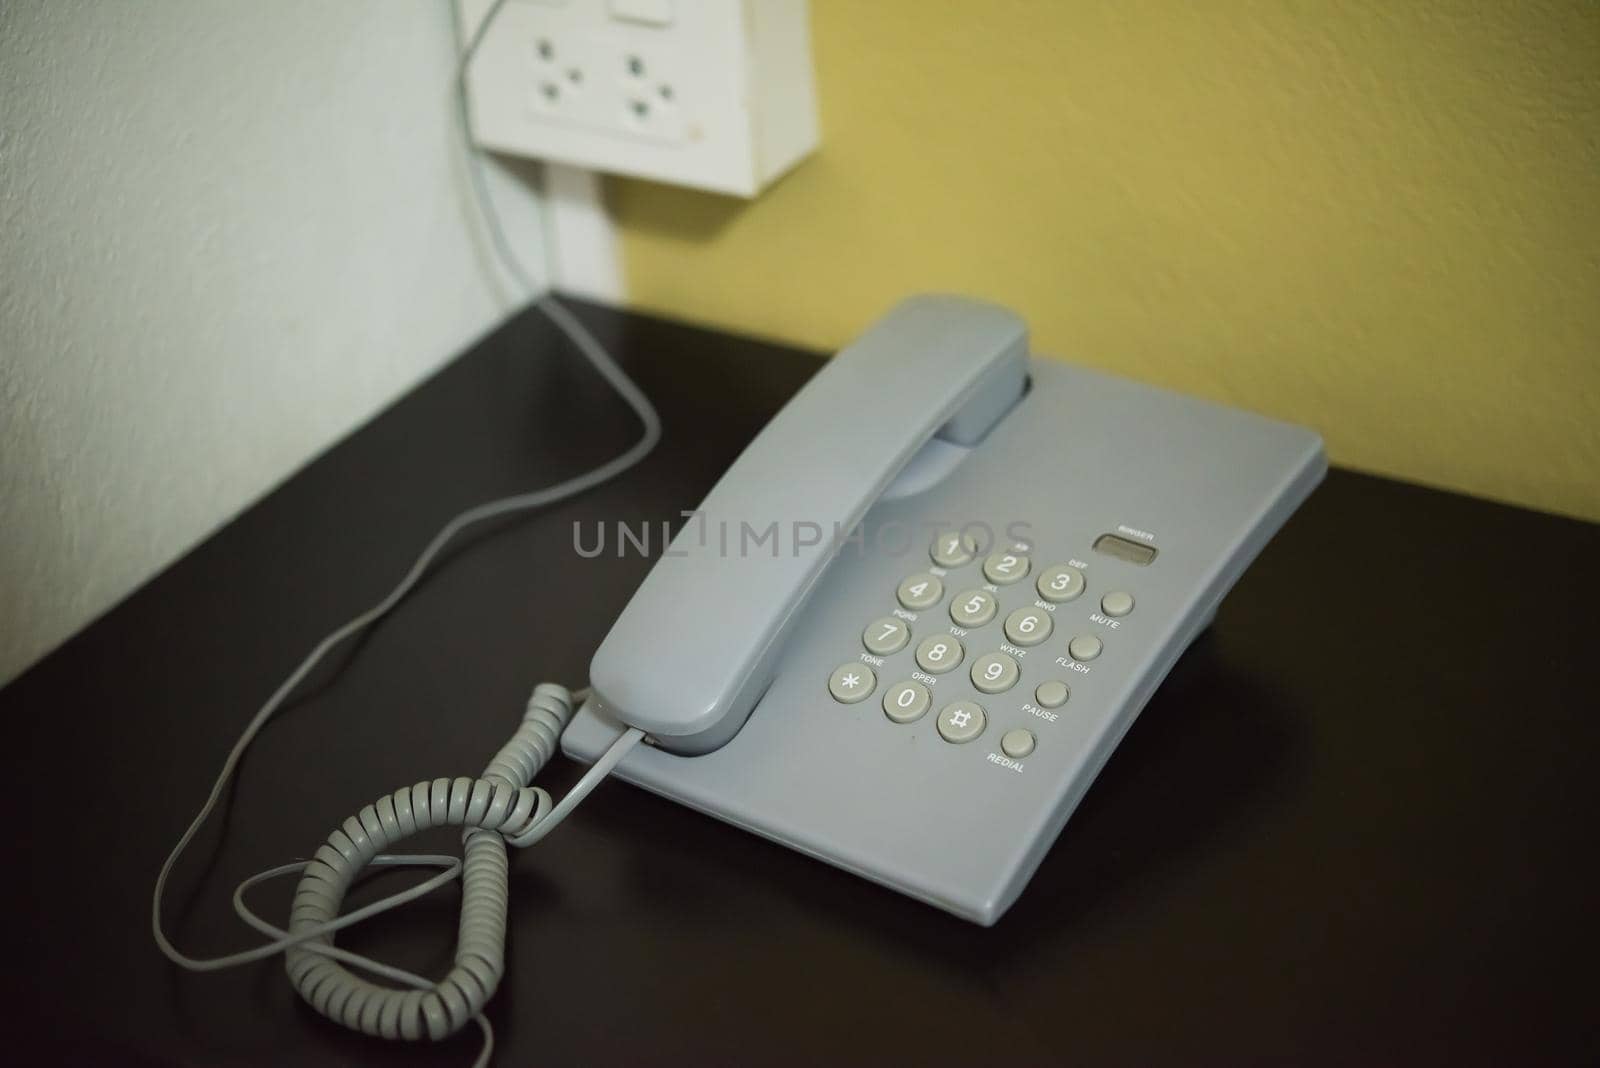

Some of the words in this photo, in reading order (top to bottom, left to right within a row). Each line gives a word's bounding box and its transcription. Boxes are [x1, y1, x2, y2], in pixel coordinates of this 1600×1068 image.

[946, 539, 959, 555] 1
[997, 556, 1017, 573] 2
[909, 582, 929, 597] 4
[1051, 573, 1071, 590] 3
[964, 596, 986, 613] 5
[1034, 600, 1056, 612] MNO
[1019, 616, 1038, 633] 6
[1089, 614, 1121, 630] MUTE
[878, 624, 898, 641] 7
[950, 627, 968, 637] TUV
[928, 643, 948, 661] 8
[1000, 643, 1027, 658] WXYZ
[859, 653, 884, 667] TONE
[1055, 656, 1090, 675] FLASH
[912, 672, 937, 686] OPER
[984, 662, 1003, 681] 9
[897, 689, 915, 707] 0
[1021, 704, 1059, 722] PAUSE
[986, 753, 1025, 773] REDIAL
